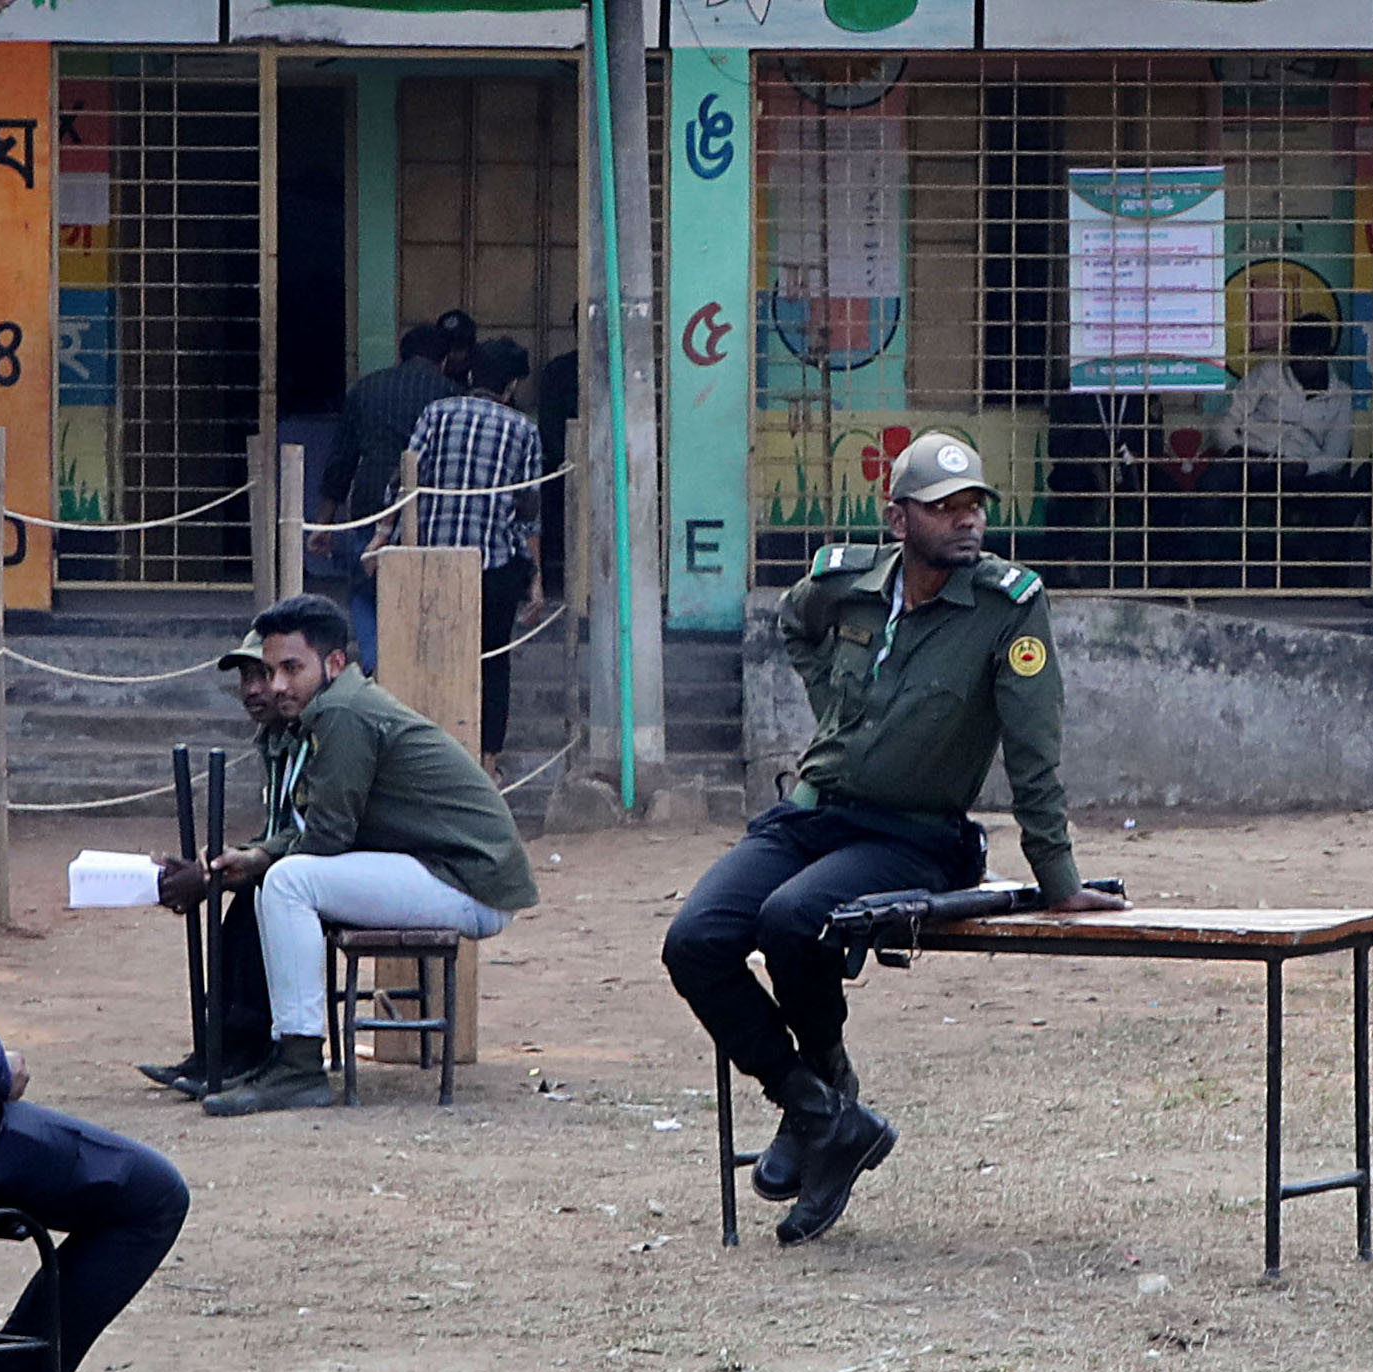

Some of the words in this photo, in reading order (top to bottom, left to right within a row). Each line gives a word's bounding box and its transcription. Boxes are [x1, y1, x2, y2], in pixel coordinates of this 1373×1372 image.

[686, 93, 734, 180] ঙ
[681, 302, 732, 366] ৫
[686, 519, 724, 574] E
